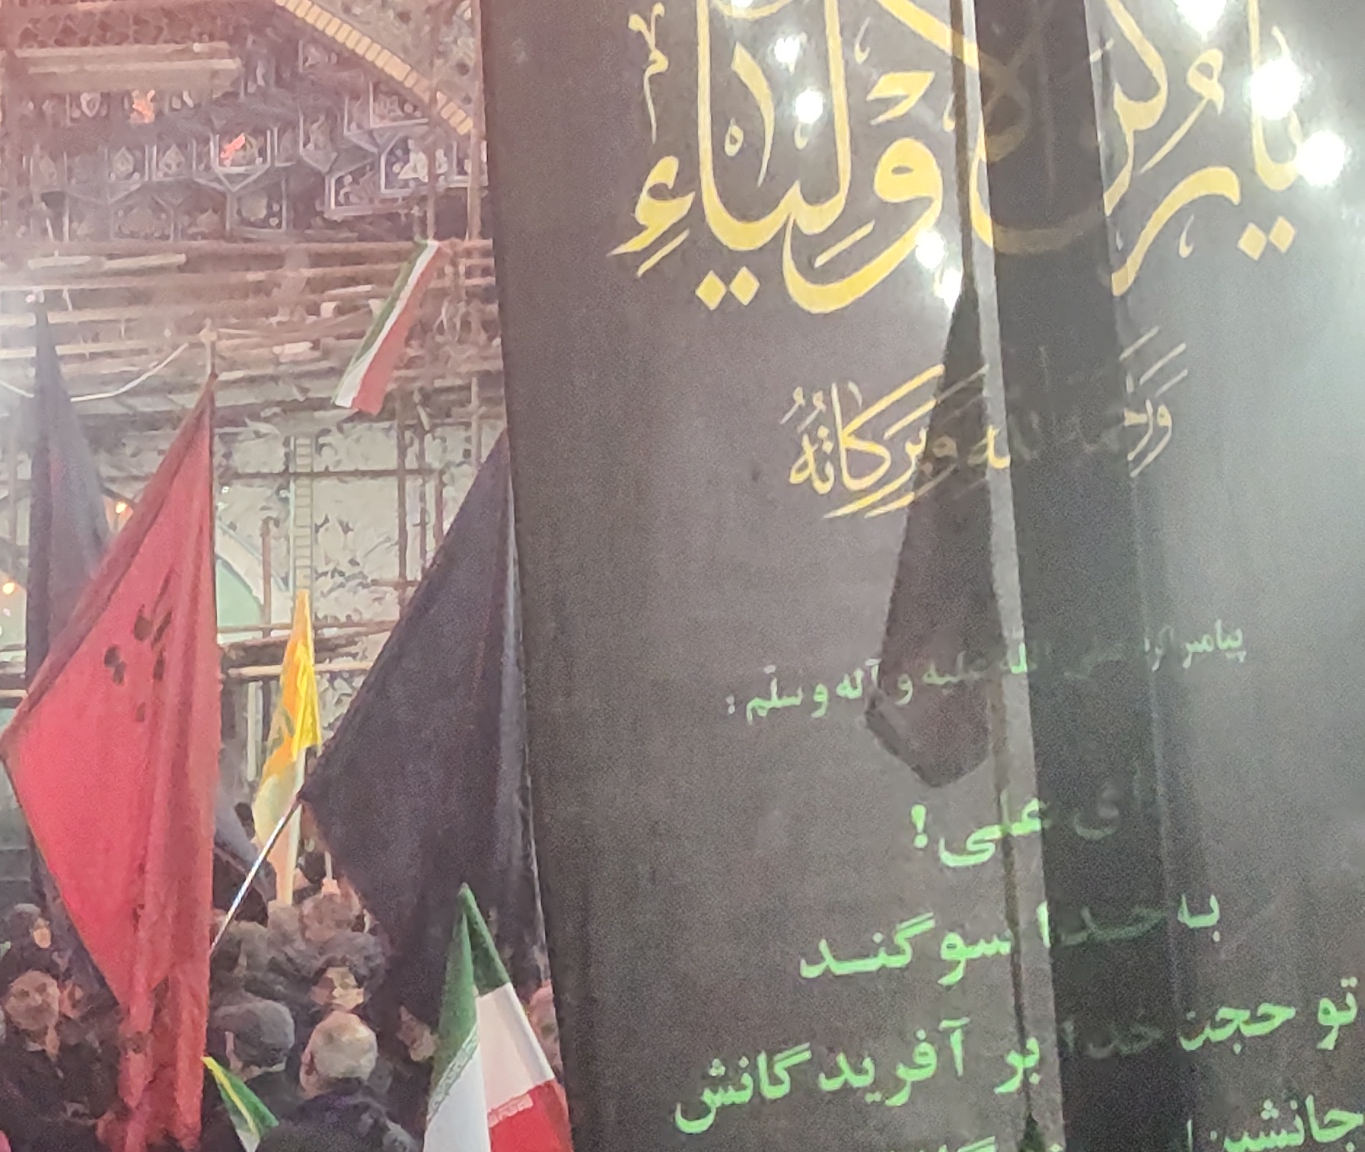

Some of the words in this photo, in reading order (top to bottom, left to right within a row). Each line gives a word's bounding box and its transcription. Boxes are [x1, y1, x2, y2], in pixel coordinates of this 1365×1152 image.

[812, 683, 829, 718] و
[1178, 893, 1221, 943] به
[1317, 976, 1359, 1051] تو
[993, 1036, 1042, 1095] بر
